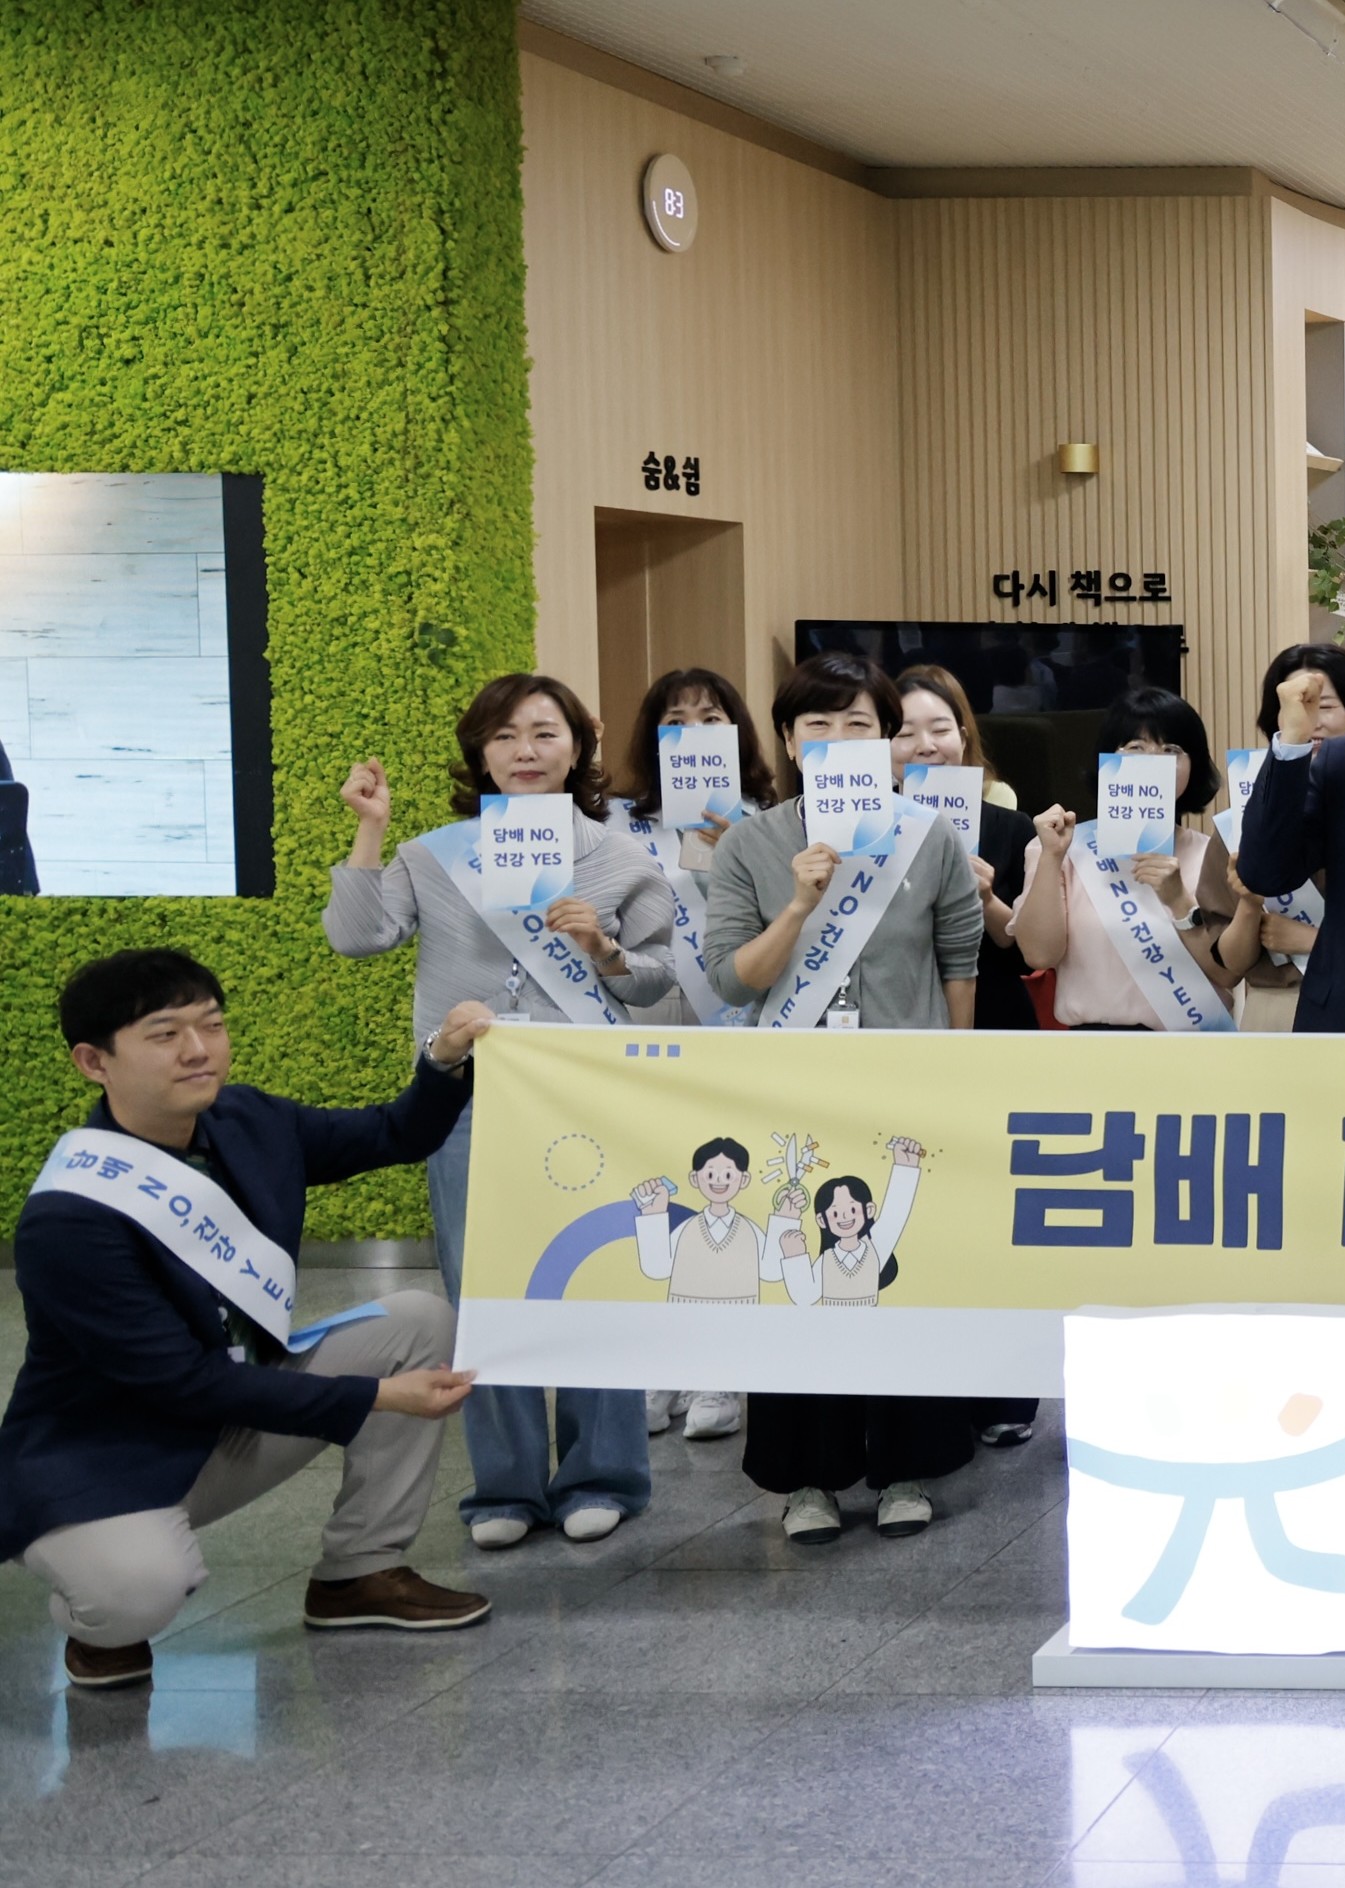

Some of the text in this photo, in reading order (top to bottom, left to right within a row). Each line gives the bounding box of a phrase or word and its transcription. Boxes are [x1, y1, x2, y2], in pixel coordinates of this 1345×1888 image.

[641, 451, 700, 496] 숨&쉼
[993, 570, 1172, 607] 다시 책으로
[670, 755, 727, 769] 담배 NO,
[671, 776, 730, 790] 건강 YES
[814, 774, 878, 789] 담배 NO,
[1108, 783, 1163, 799] 담배 NO,
[816, 798, 882, 814] 건강 YES
[944, 795, 968, 810] NO,
[1108, 805, 1165, 820] 건강 YES
[493, 828, 559, 844] 담배 NO,
[494, 852, 525, 868] 건강
[531, 852, 562, 866] YES
[1159, 966, 1203, 1025] YES
[65, 1149, 134, 1180] 담배
[1006, 1110, 1287, 1251] 담배
